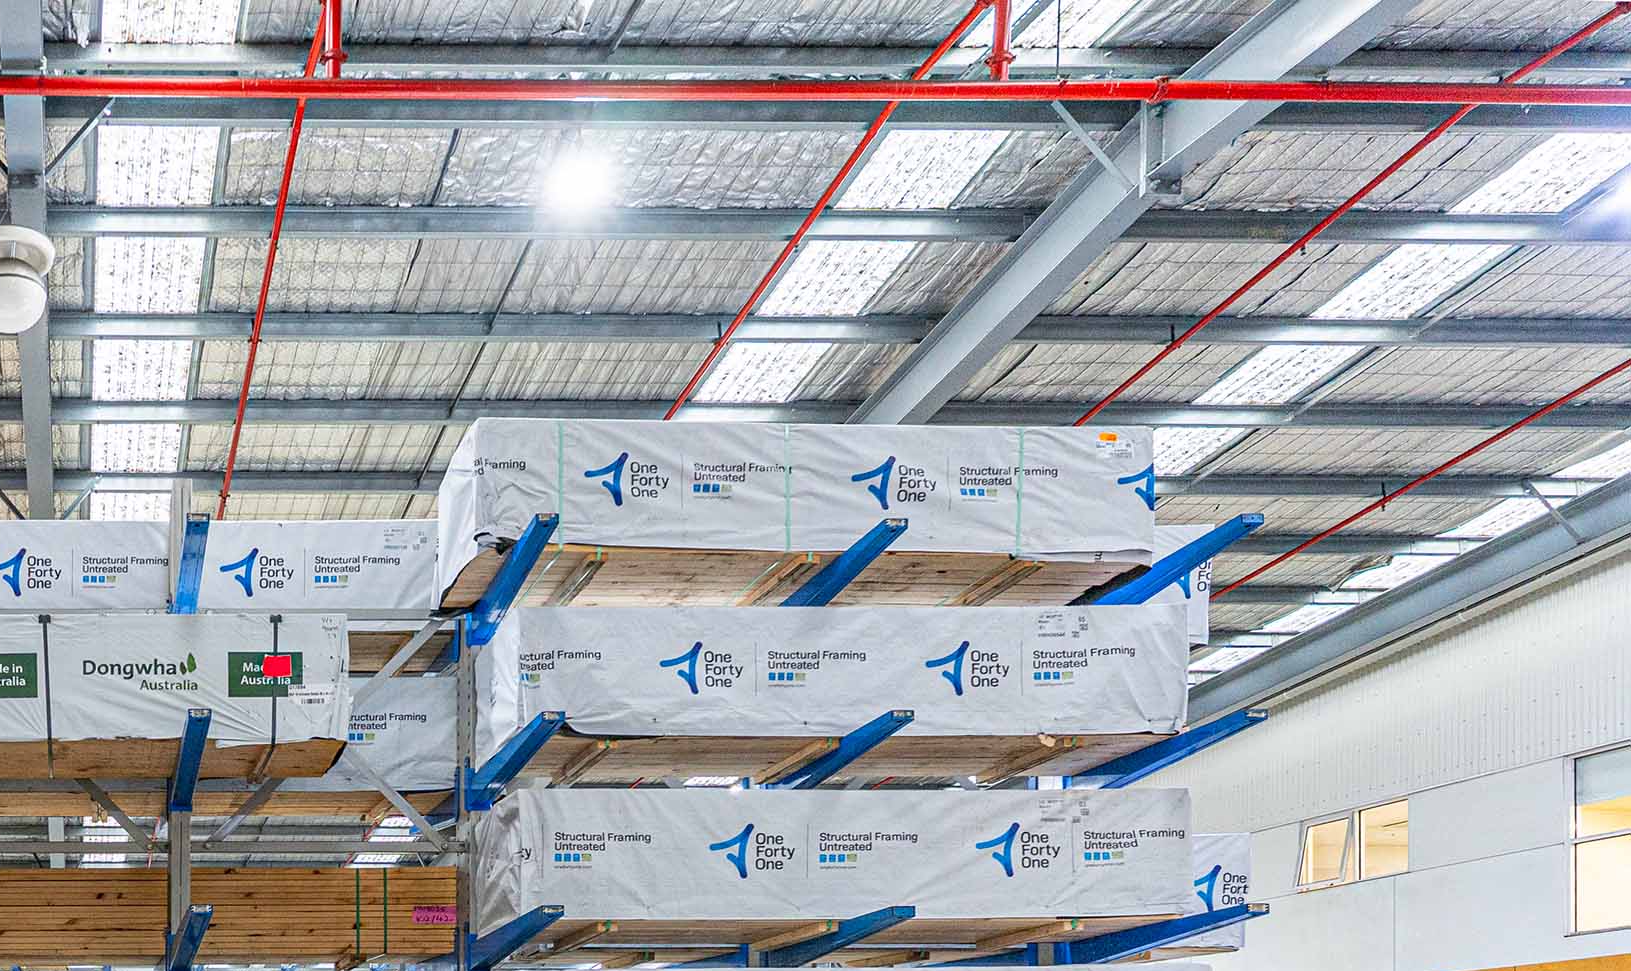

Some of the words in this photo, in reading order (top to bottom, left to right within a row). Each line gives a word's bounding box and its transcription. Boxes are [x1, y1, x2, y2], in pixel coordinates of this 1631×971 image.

[630, 462, 658, 474] One
[694, 462, 746, 472] Structural
[899, 465, 924, 477] One
[960, 466, 1010, 476] Structural
[631, 474, 669, 489] Forty
[694, 472, 746, 482] Untreated
[960, 477, 1012, 486] Untreated
[899, 477, 936, 491] Forty
[631, 486, 658, 498] One
[897, 490, 926, 502] One
[27, 556, 52, 566] One
[83, 556, 128, 564] Structural
[130, 557, 168, 567] Framing
[260, 556, 284, 566] One
[315, 556, 360, 564] Structural
[363, 556, 400, 566] Framing
[28, 567, 61, 580] Forty
[83, 565, 128, 573] Untreated
[260, 567, 294, 580] Forty
[314, 564, 360, 573] Untreated
[28, 578, 52, 588] One
[260, 578, 284, 588] One
[704, 651, 732, 663] One
[768, 650, 820, 659] Structural
[822, 650, 866, 661] Framing
[971, 650, 998, 662] One
[1033, 649, 1086, 659] Structural
[1090, 648, 1135, 657] Framing
[12, 664, 22, 672] in
[83, 658, 176, 680] Dongwha
[768, 660, 820, 670] Untreated
[1033, 658, 1088, 669] Untreated
[706, 664, 743, 678] Forty
[972, 663, 1009, 677] Forty
[140, 680, 198, 690] Australia
[241, 675, 290, 685] Austrlia
[705, 676, 732, 688] One
[971, 676, 999, 687] One
[389, 713, 426, 723] Framing
[555, 832, 604, 841] Structural
[608, 832, 651, 844] Framing
[756, 833, 783, 844] One
[820, 832, 872, 841] Structural
[875, 832, 918, 843] Framing
[1020, 832, 1048, 843] One
[1084, 830, 1136, 839] Structural
[1139, 828, 1184, 839] Framing
[555, 842, 605, 851] Untreated
[820, 842, 872, 851] Untreated
[1084, 839, 1138, 850] Untreated
[756, 846, 795, 860] Forty
[1022, 844, 1060, 858] Forty
[756, 858, 783, 870] One
[1022, 856, 1049, 868] One
